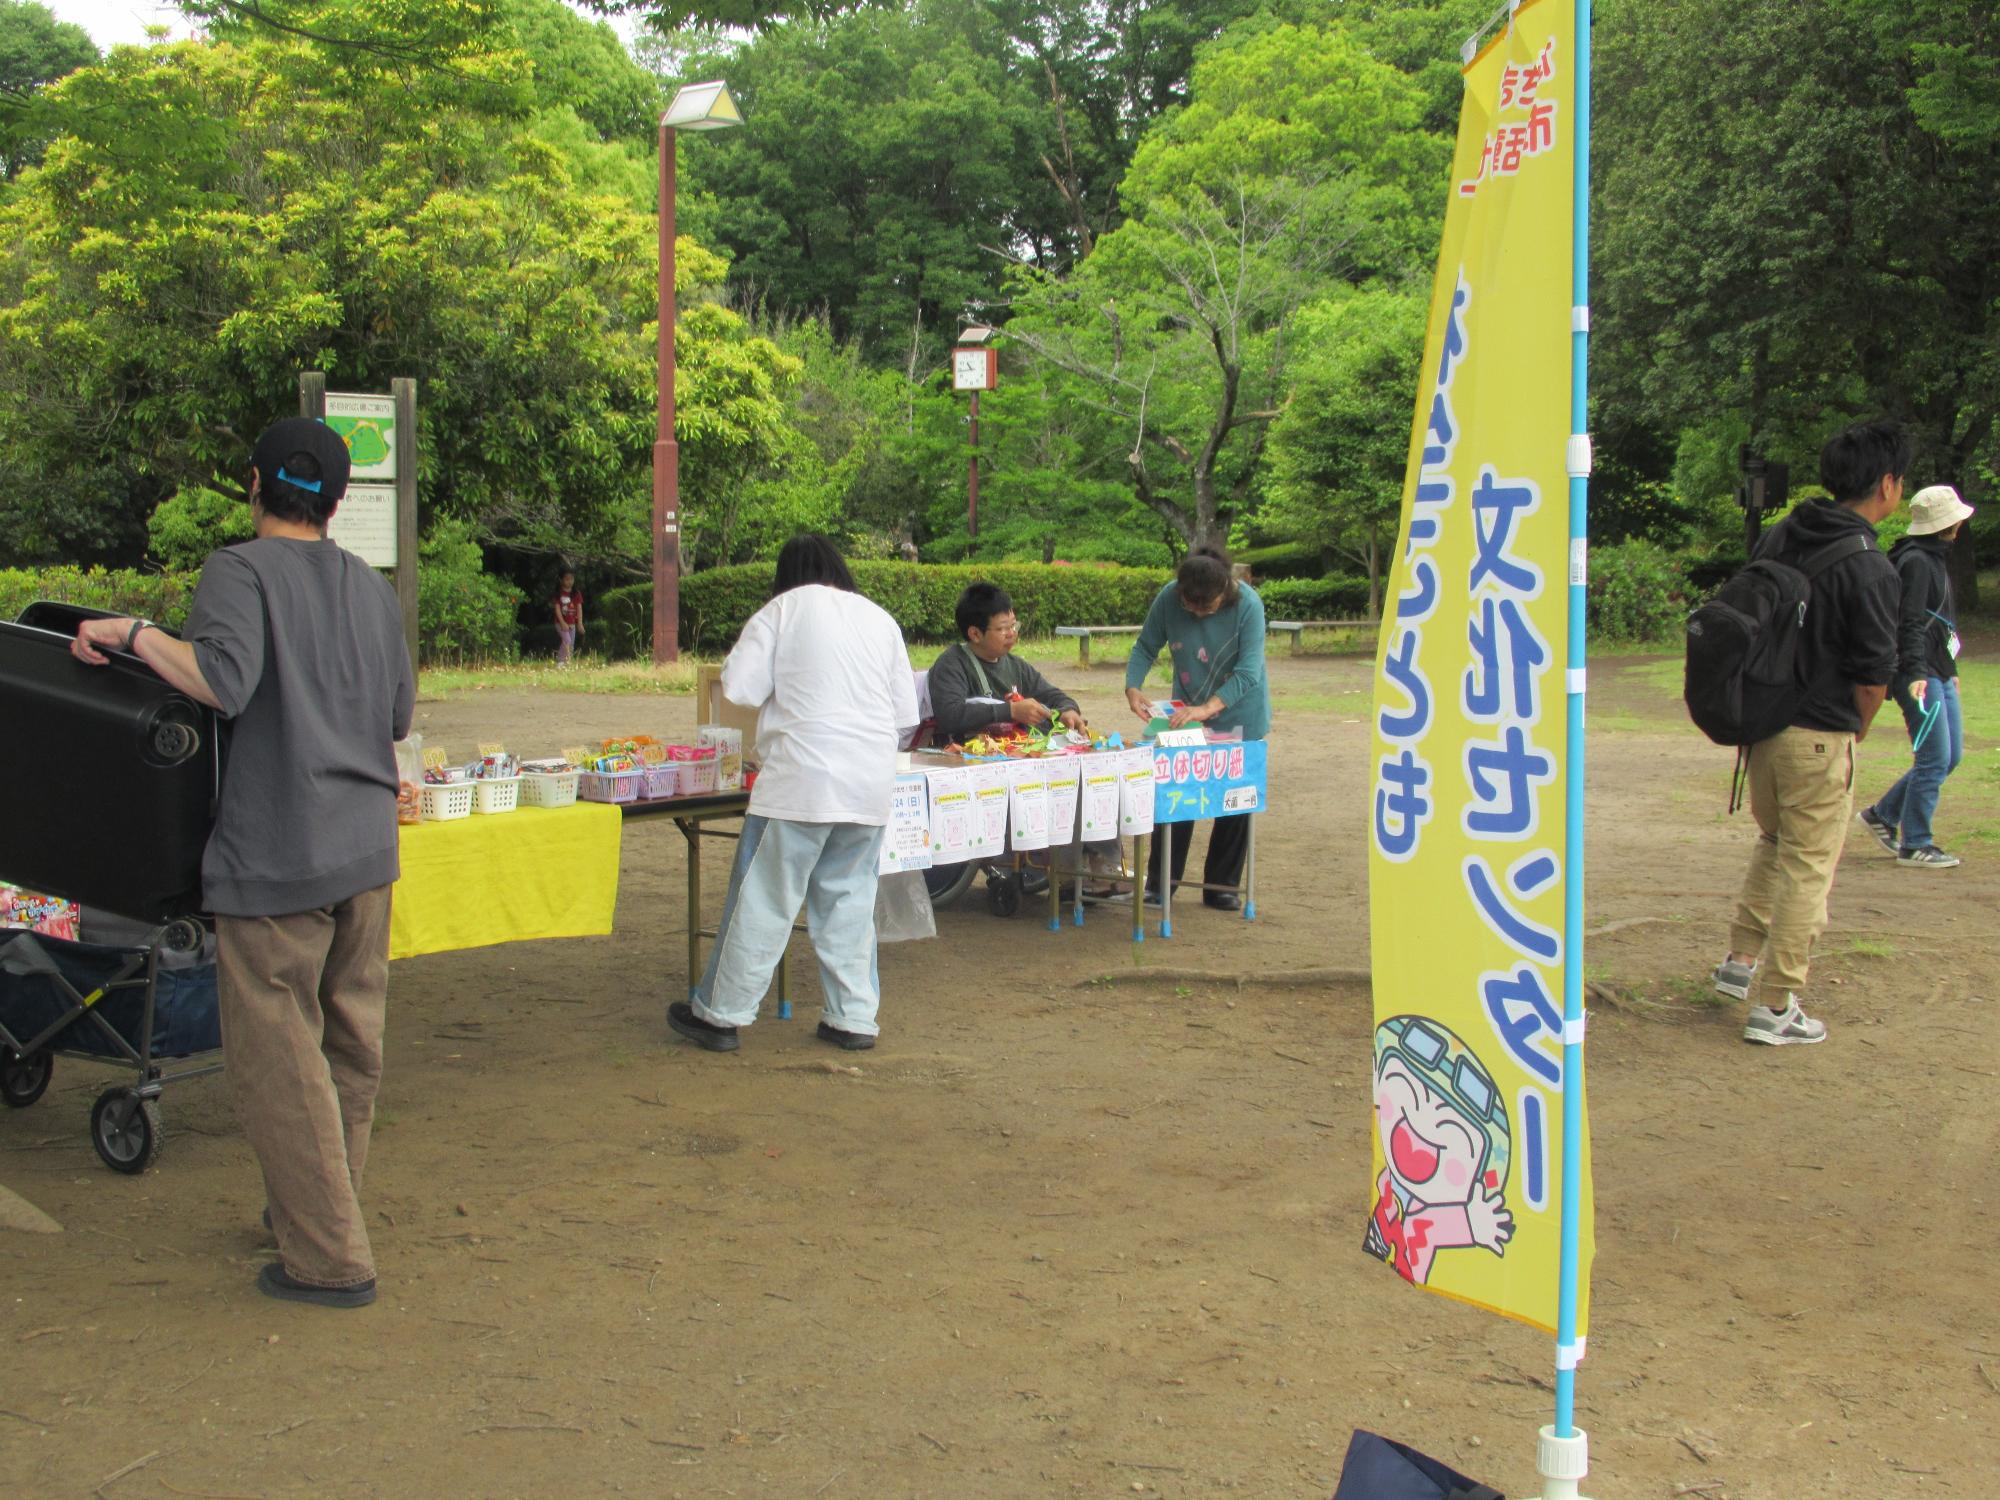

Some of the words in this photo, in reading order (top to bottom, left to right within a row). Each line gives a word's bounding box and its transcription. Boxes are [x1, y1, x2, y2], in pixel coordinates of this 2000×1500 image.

[345, 494, 391, 504] 者へのお願い
[1155, 748, 1243, 782] 立体切り紙
[1167, 787, 1210, 815] アート
